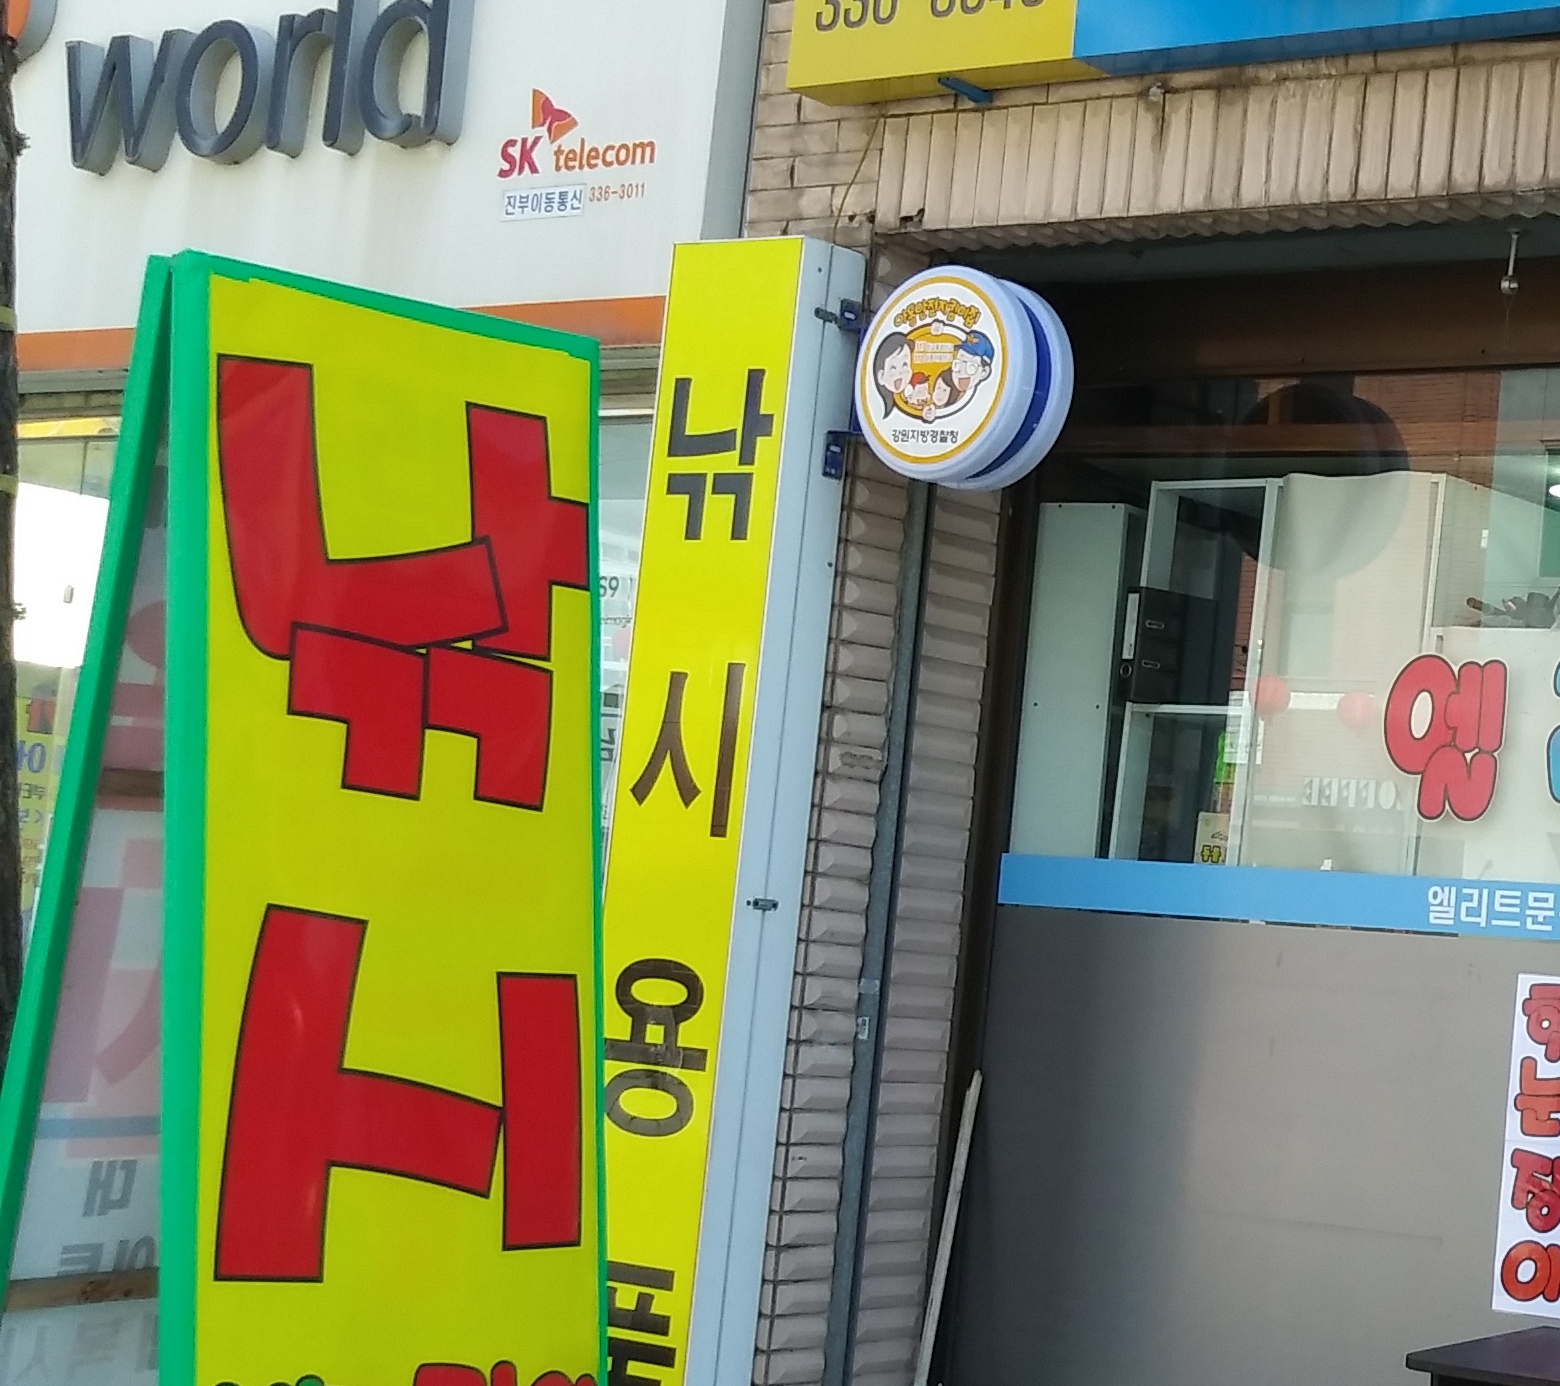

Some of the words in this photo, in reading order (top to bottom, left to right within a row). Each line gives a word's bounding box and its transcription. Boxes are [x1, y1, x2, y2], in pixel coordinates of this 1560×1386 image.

[497, 135, 544, 179] SK
[553, 137, 657, 173] telecom
[504, 189, 584, 216] 진부이동통신
[588, 182, 647, 203] 336-3011
[891, 428, 960, 445] 강원지방경찰청
[213, 351, 593, 1284] 낚시
